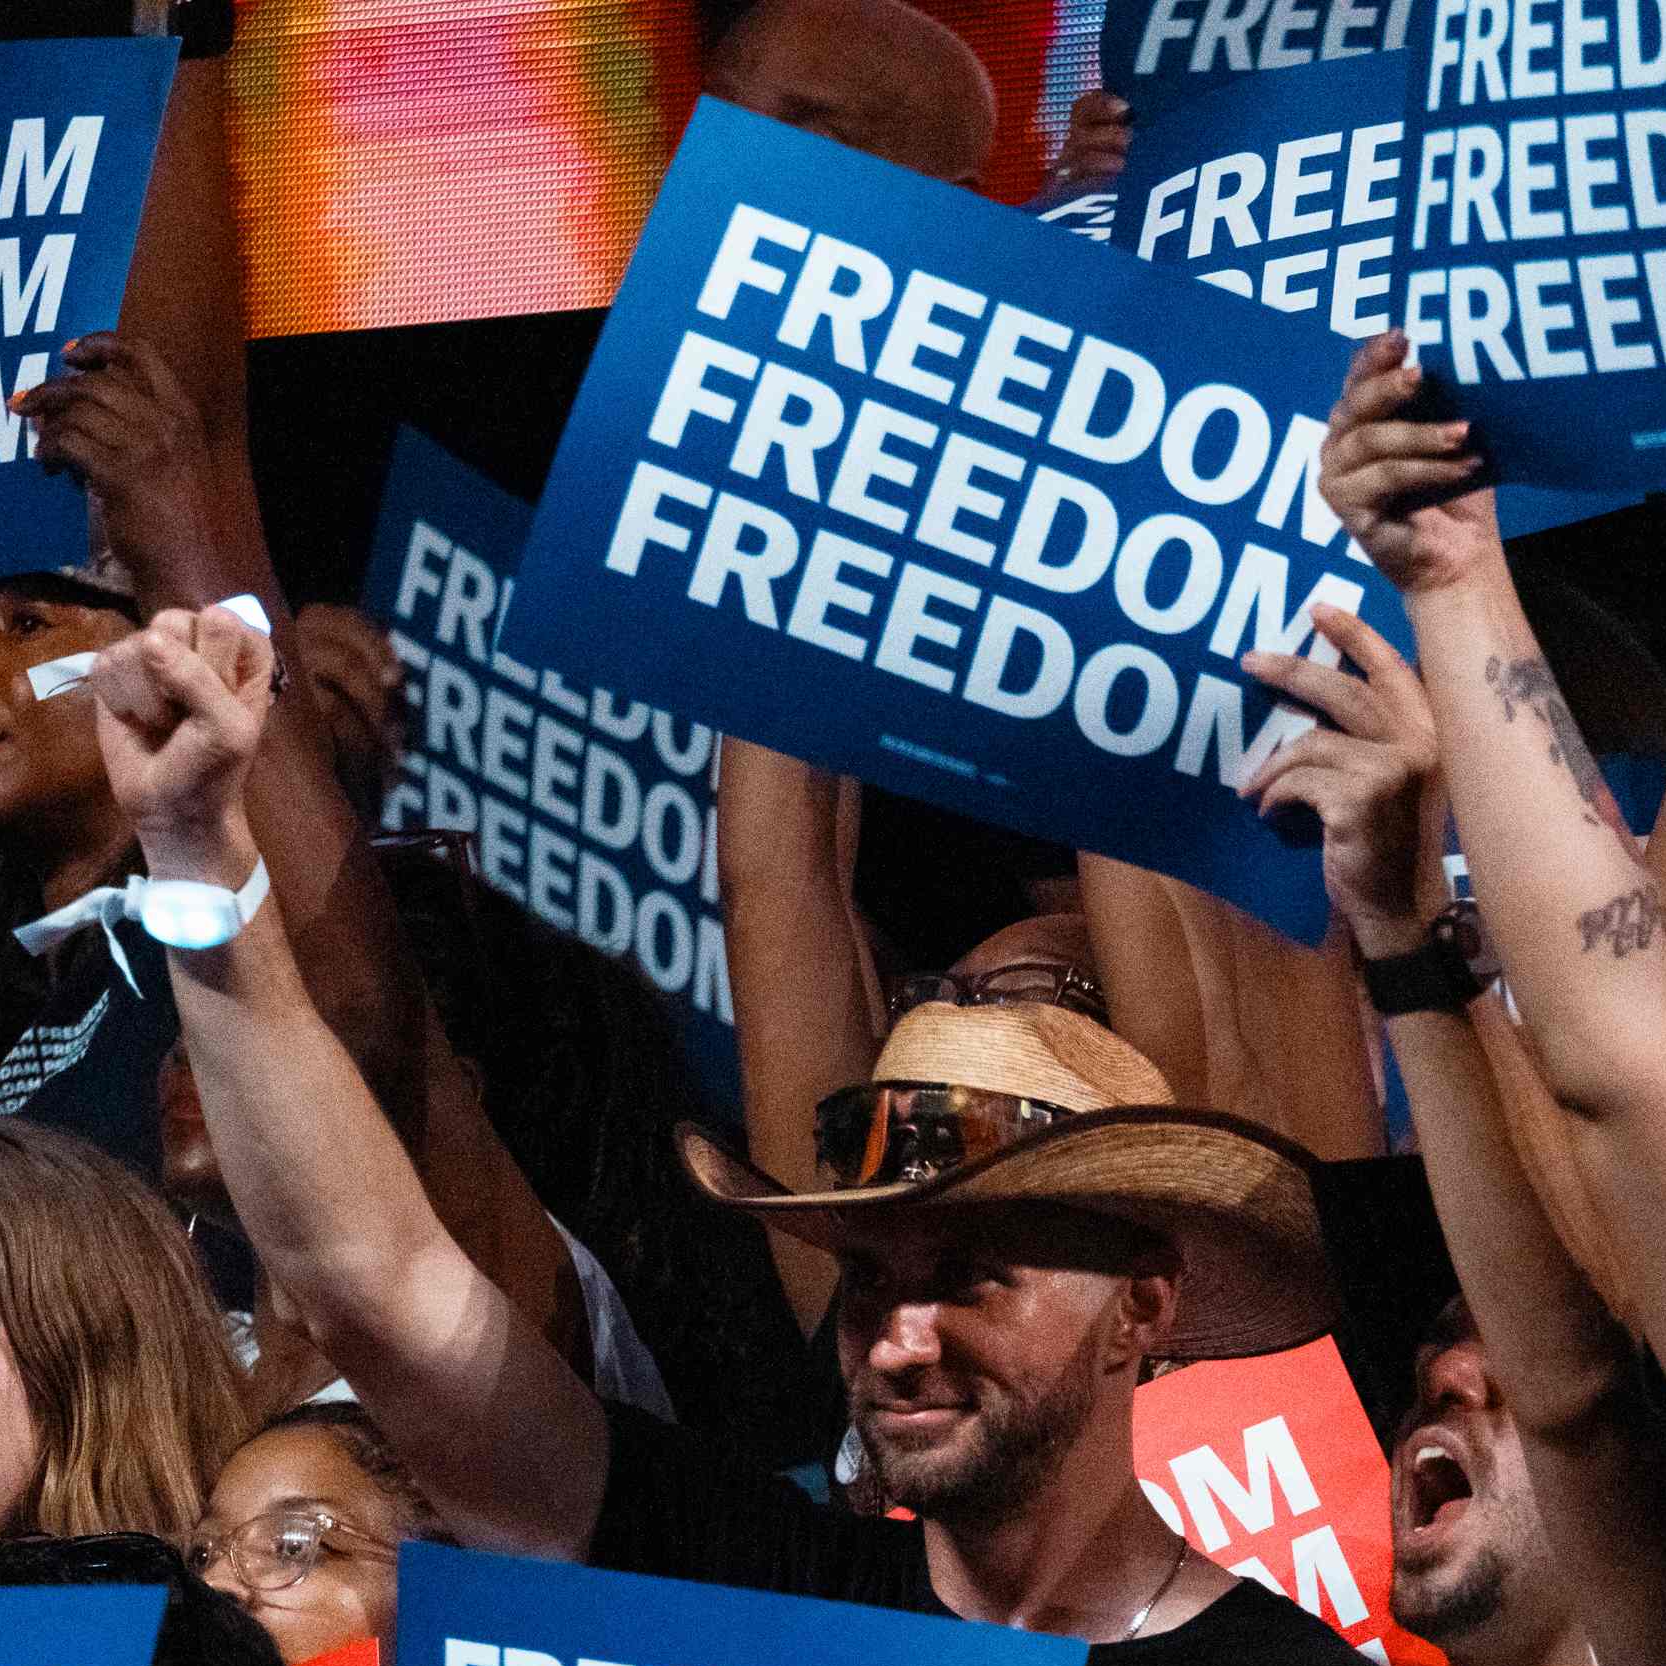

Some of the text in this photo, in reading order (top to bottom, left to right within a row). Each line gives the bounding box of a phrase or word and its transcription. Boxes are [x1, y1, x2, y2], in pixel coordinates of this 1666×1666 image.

[1136, 120, 1406, 262] FREE
[649, 330, 1366, 690] FREEDOM
[695, 202, 1374, 568] FREEDOM
[606, 460, 1321, 794] FREEDOM
